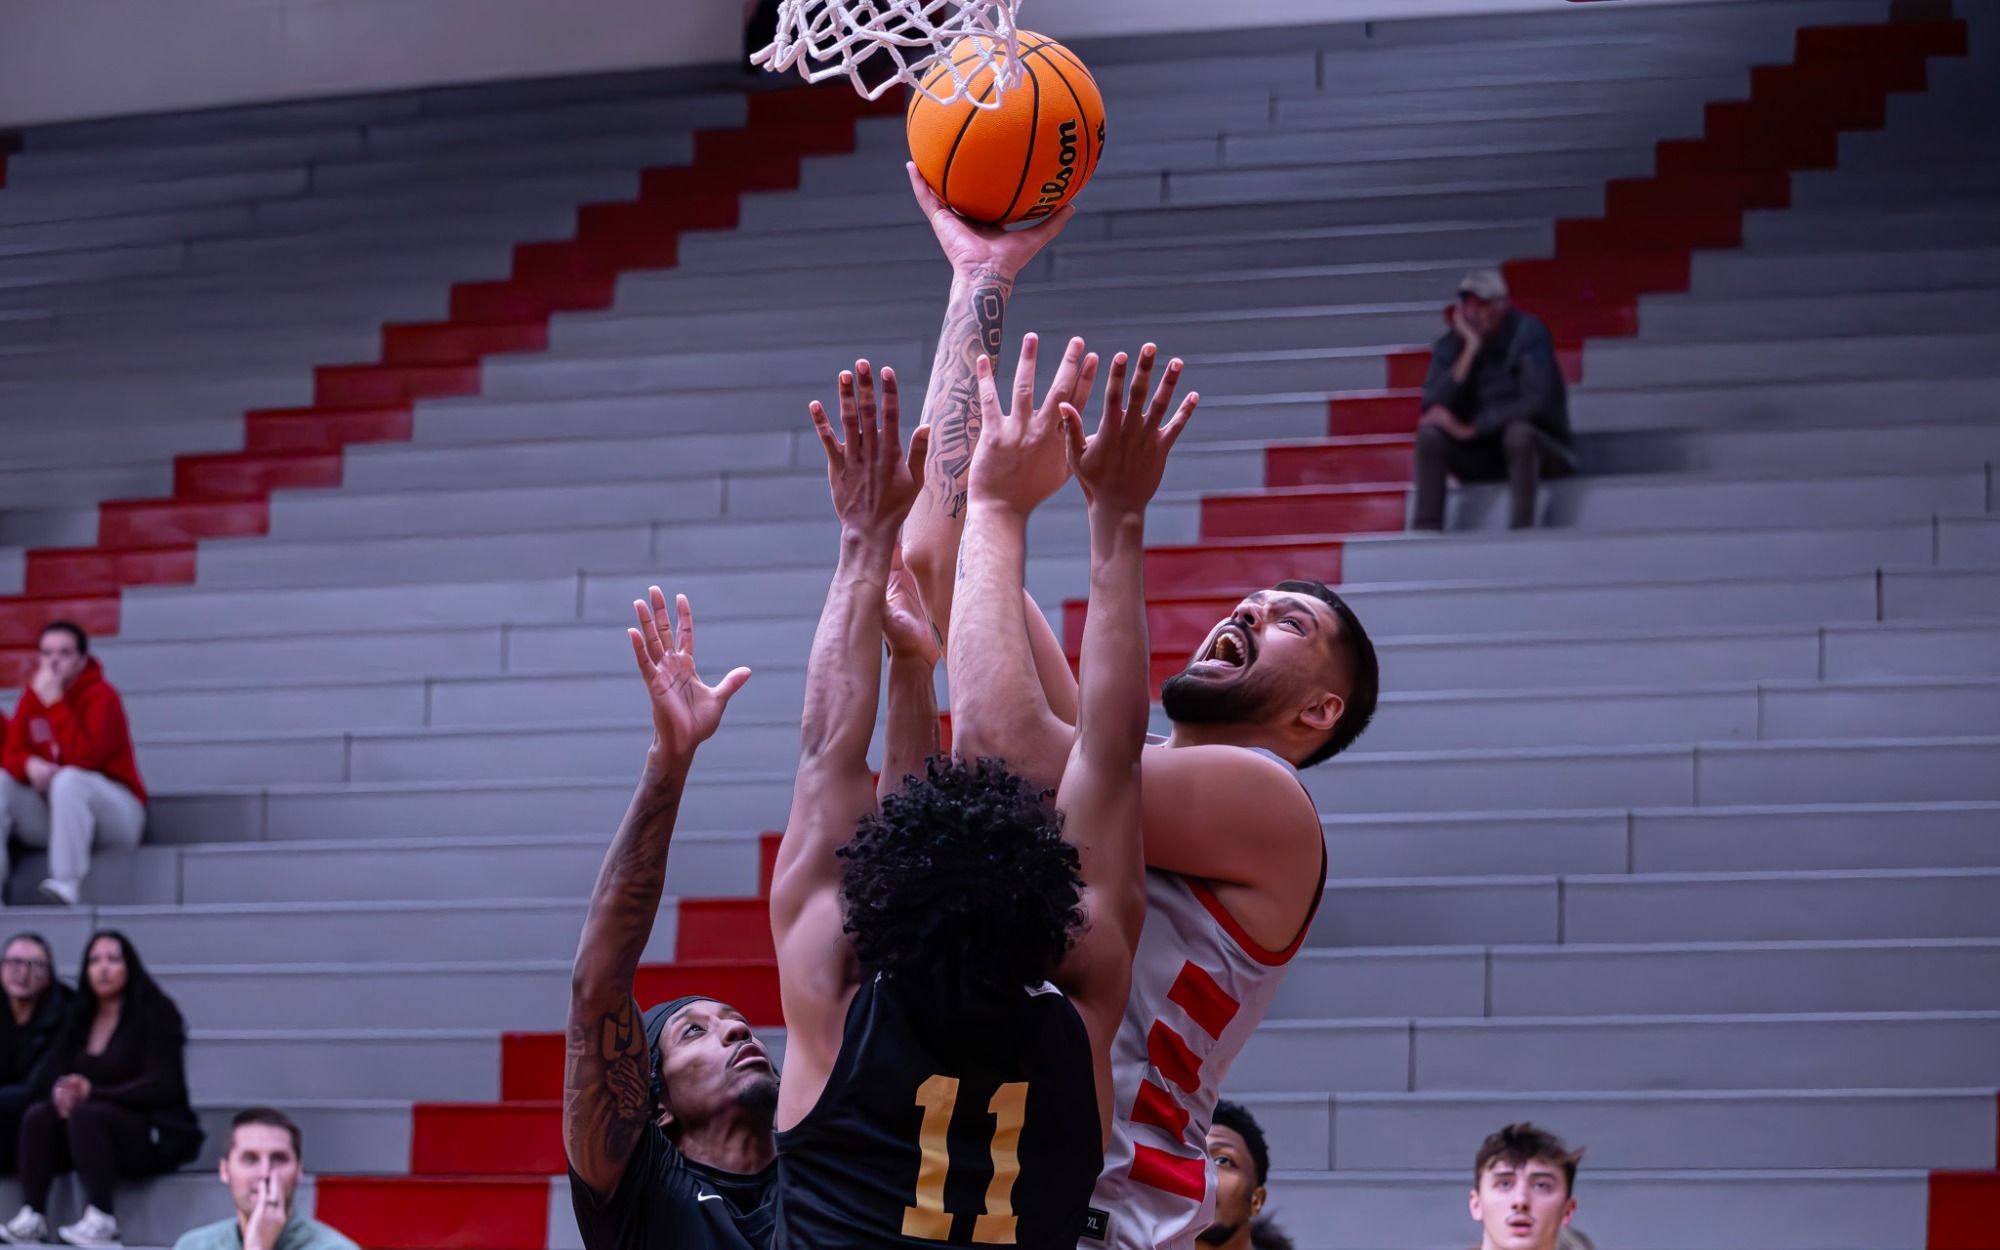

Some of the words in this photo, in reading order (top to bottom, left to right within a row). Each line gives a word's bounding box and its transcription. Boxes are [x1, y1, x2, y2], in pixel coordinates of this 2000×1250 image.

[1022, 118, 1077, 220] Wilson
[901, 1074, 1030, 1245] 11
[1086, 1216, 1099, 1230] XL
